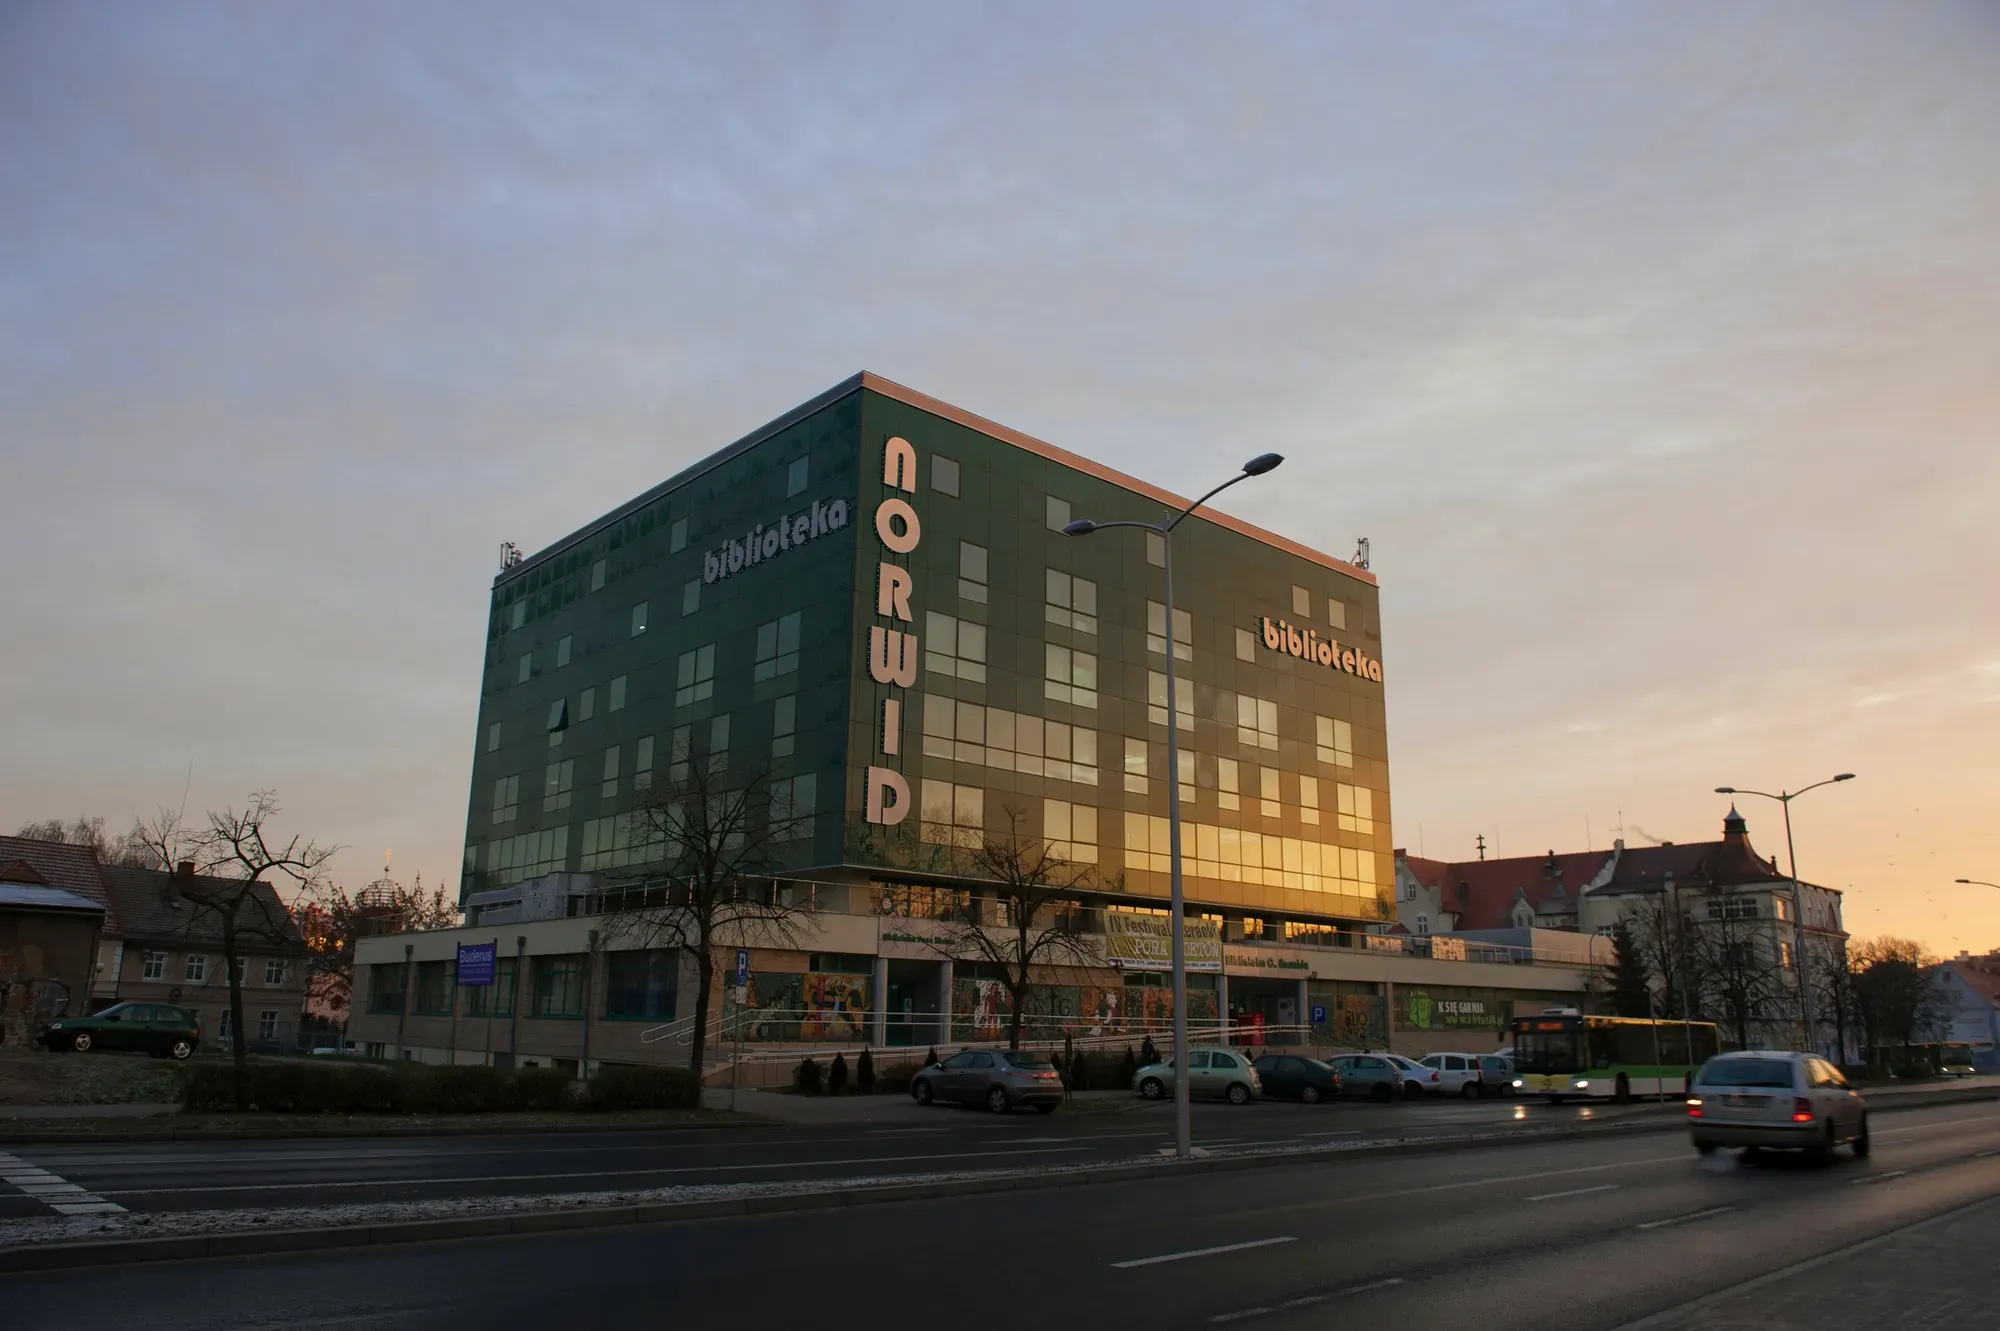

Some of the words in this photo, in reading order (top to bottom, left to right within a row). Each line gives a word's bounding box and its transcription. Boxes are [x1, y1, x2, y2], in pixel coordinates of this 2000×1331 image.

[704, 499, 850, 583] biblioteka
[865, 437, 920, 826] NORWID
[1263, 617, 1382, 682] biblioteka
[1124, 916, 1172, 936] Festiwal
[459, 949, 492, 963] Buderus
[1135, 939, 1168, 956] PORA
[738, 953, 747, 975] P
[1225, 955, 1266, 967] Biblioteka
[1314, 1007, 1323, 1021] P
